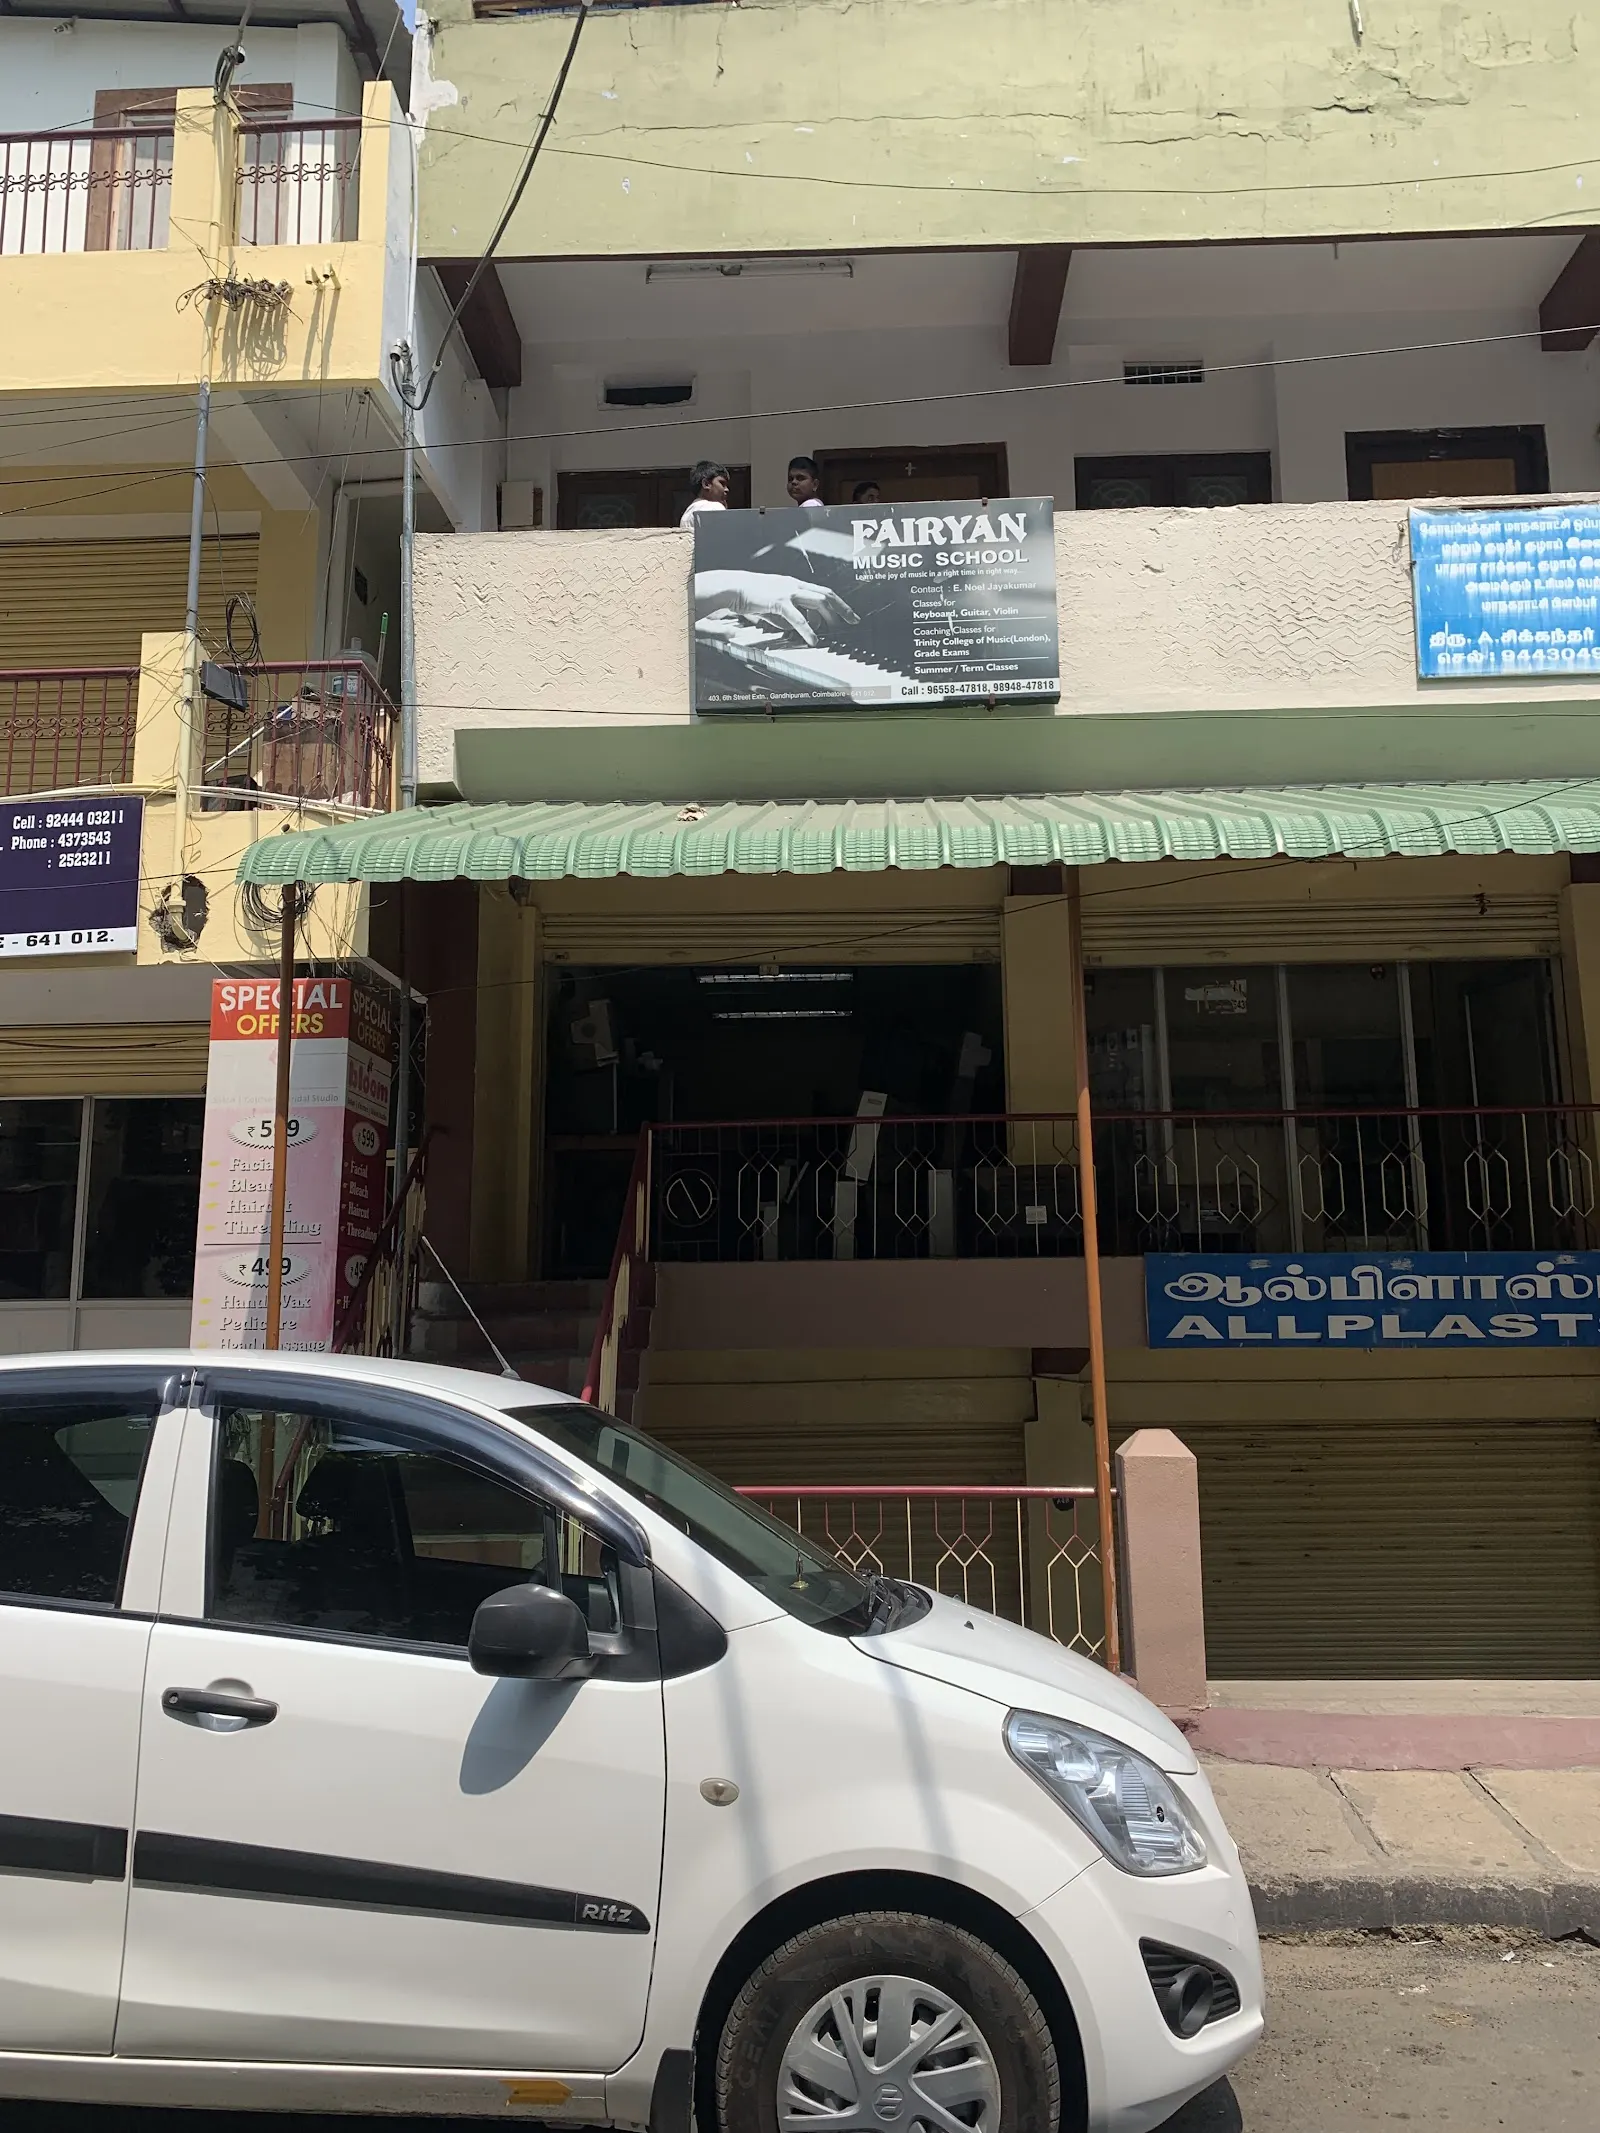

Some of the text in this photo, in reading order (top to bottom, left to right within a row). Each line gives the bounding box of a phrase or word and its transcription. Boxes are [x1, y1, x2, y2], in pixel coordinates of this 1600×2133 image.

[851, 513, 1028, 550] FAIRYAN
[853, 549, 1029, 569] MUSIC SCHOOL
[855, 573, 874, 581] Learn
[887, 572, 899, 581] joy
[943, 569, 960, 577] right
[985, 567, 1001, 576] right
[910, 585, 943, 594] Contact
[953, 584, 963, 592] E.
[964, 583, 985, 592] Noel
[987, 581, 1037, 592] Jayakumar
[912, 599, 956, 608] Classes for
[912, 607, 1019, 620] Keyboard, Guitar, Violin
[913, 625, 996, 636] Coaching Classes for
[913, 638, 941, 648] Trinity
[942, 637, 974, 647] College
[976, 636, 984, 644] of
[914, 649, 970, 658] Grade Exams
[914, 665, 953, 674] Summer
[960, 664, 984, 673] Term
[986, 663, 1019, 672] Classes
[812, 690, 846, 699] Coimbatore
[901, 685, 919, 696] Call
[927, 683, 991, 695] 96558-47818,
[993, 681, 1054, 692] 98948-47818
[12, 815, 36, 829] Cell
[46, 812, 84, 828] 92444
[87, 810, 124, 825] 03211
[11, 835, 48, 850] Phone
[57, 830, 111, 847] 4373543
[58, 851, 111, 868] 2523211
[26, 933, 61, 947] 641
[353, 988, 392, 1035] SPECIAL
[357, 1022, 386, 1053] OFFERS
[348, 1060, 388, 1103] bloom
[312, 1093, 339, 1103] Studio
[260, 1119, 300, 1138] 59
[350, 1160, 368, 1179] Facial
[349, 1180, 369, 1200] Bleach
[347, 1201, 370, 1220] Haircut
[346, 1222, 378, 1245] Threading
[582, 1903, 633, 1923] Ritz
